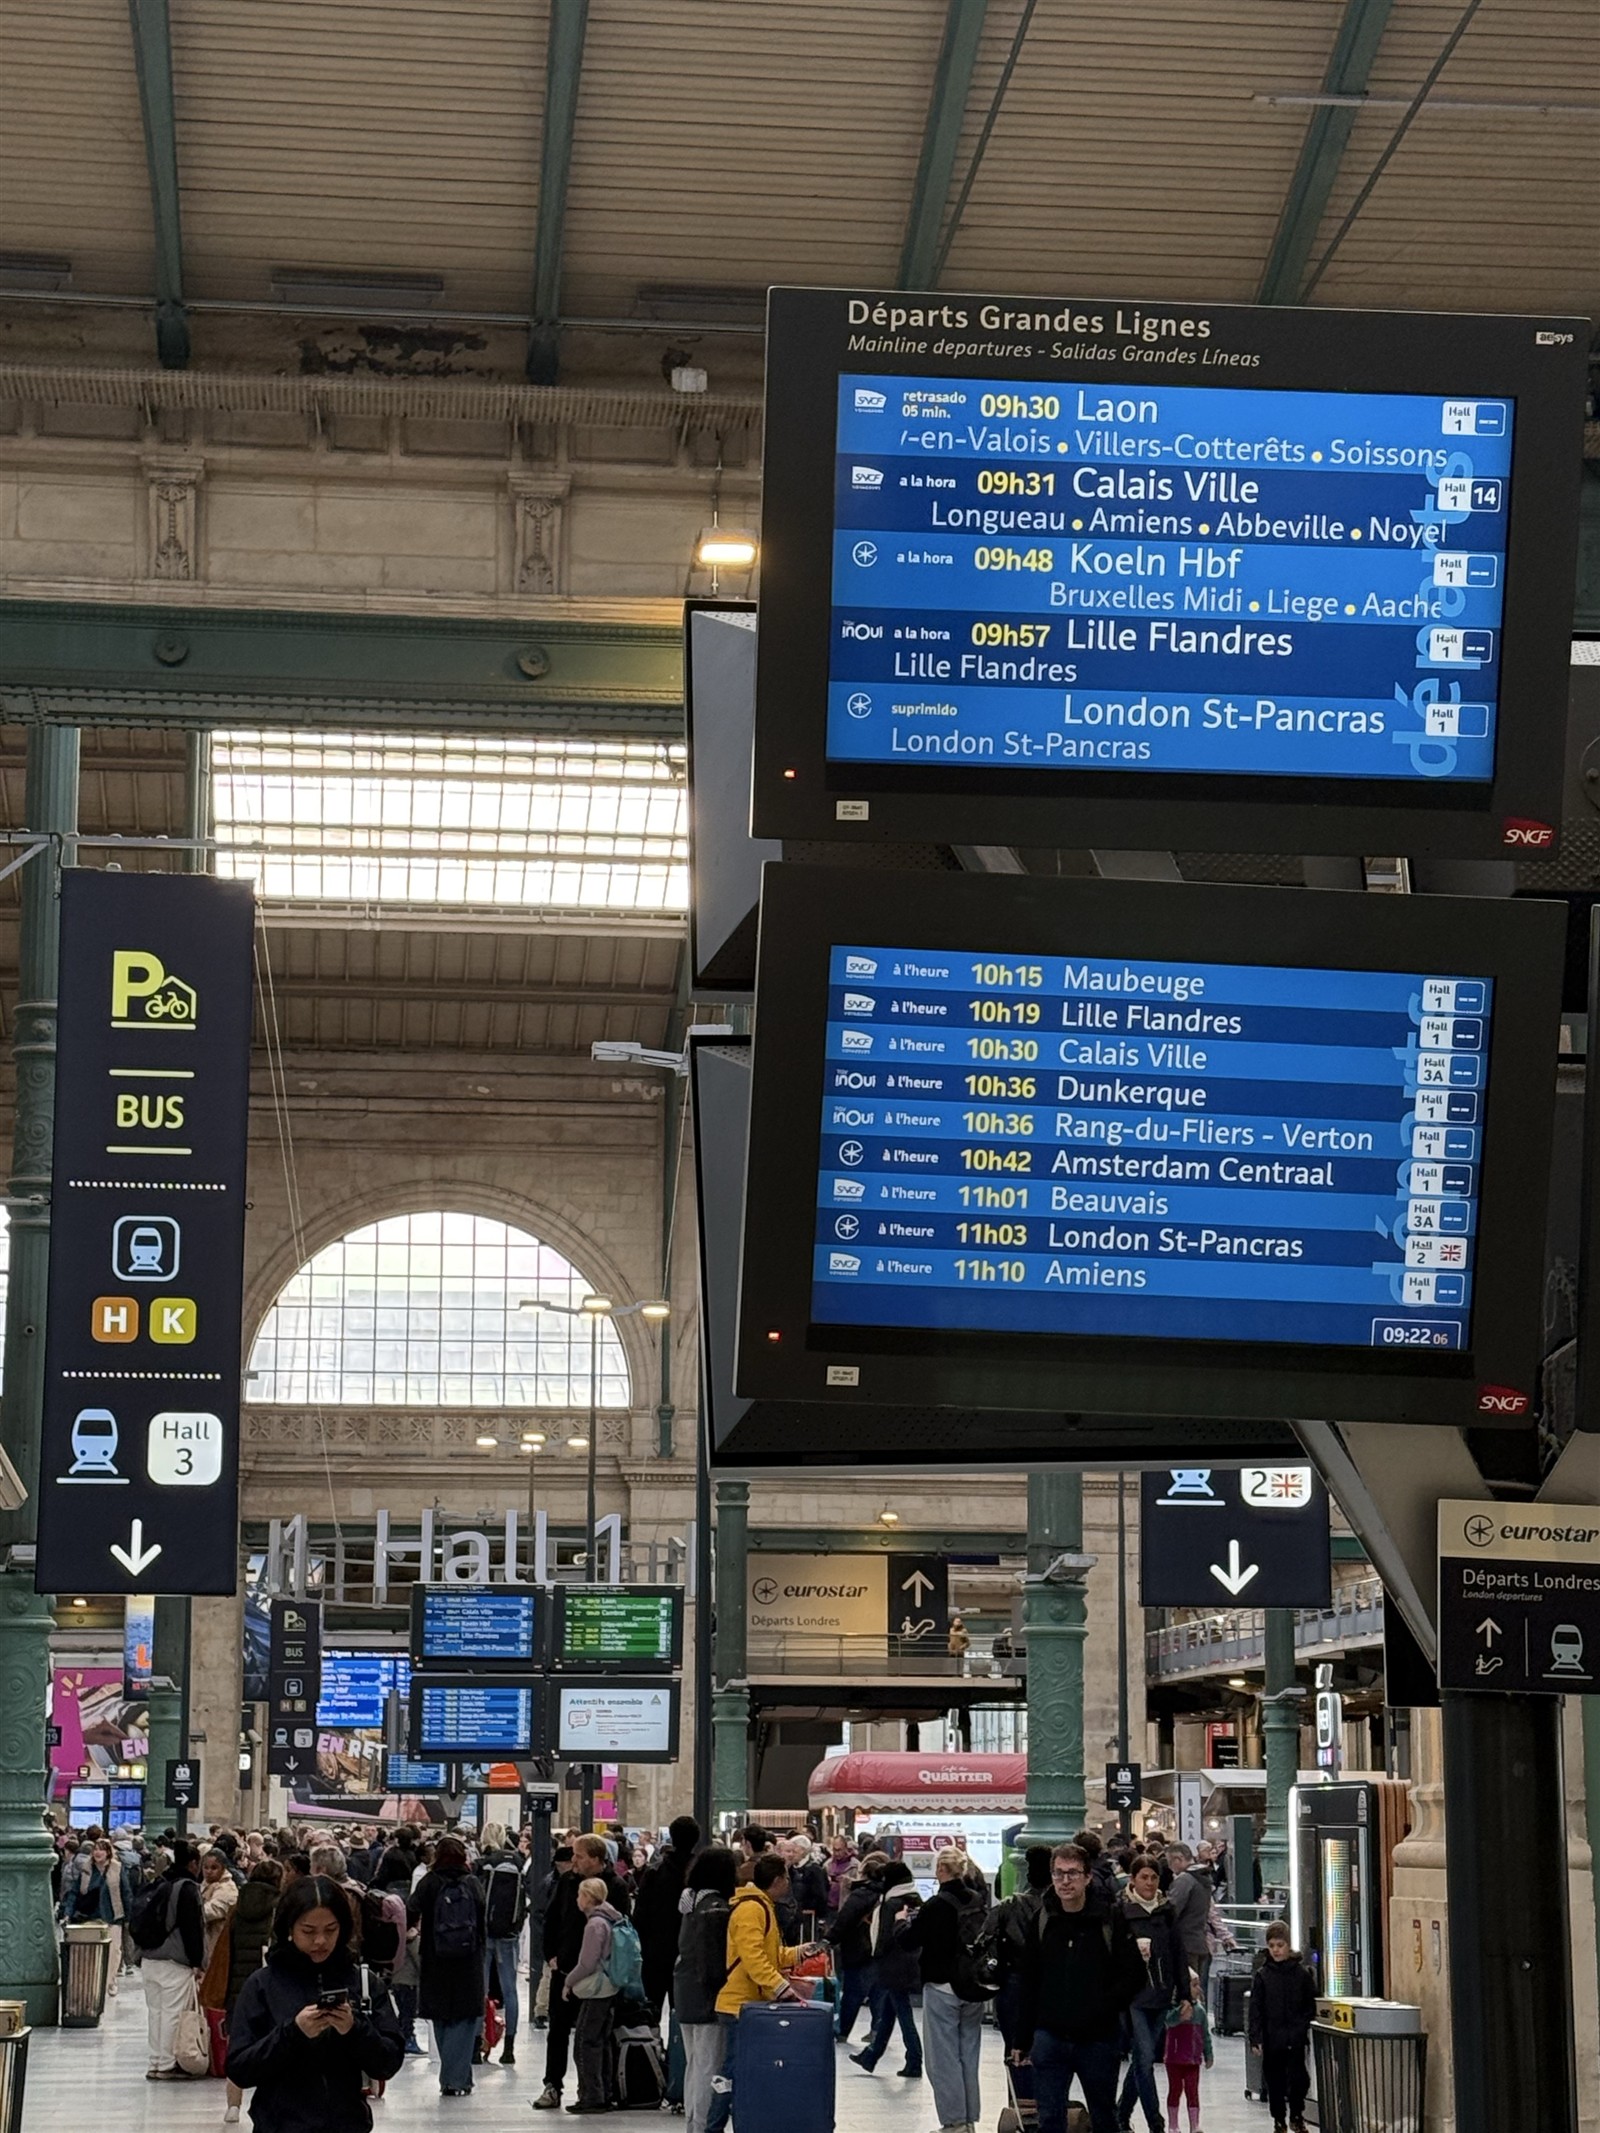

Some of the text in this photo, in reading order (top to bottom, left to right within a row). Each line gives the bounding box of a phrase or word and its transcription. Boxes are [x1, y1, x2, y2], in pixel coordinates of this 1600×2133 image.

[848, 300, 1211, 341] Départs Grandes Lignes
[848, 335, 1260, 367] Mainline departures Salidas Grandes Líneas
[902, 405, 951, 419] 05 min.
[903, 390, 1159, 423] retrasado 09h30 Laon
[1449, 405, 1471, 417] Hall
[1454, 419, 1463, 432] 1
[1075, 430, 1305, 463] Villers-Cotterêts
[1329, 438, 1448, 468] Soissons
[899, 467, 1259, 504] a la hora 09h31 Calais Ville
[1444, 483, 1497, 506] Hall 14
[1450, 495, 1458, 508] 1
[931, 501, 1448, 549] Longueau Amiens Abbeville Noyel
[896, 543, 1243, 579] a la hora 09h48 Koeln Hbf
[1440, 558, 1462, 570] Hall
[1445, 571, 1454, 583] 1
[1050, 582, 1442, 621] Bruxelles Midi Liege Aache
[893, 629, 903, 639] a
[905, 626, 918, 640] la
[920, 627, 951, 640] hora
[971, 622, 1051, 648] 09h57
[1066, 619, 1137, 651] Lille
[1150, 621, 1294, 656] Flandres
[1435, 633, 1458, 645] Hall
[1442, 646, 1450, 658] 1
[894, 652, 1078, 682] Lille Flandres
[891, 694, 1385, 734] suprimido London St-Pancras
[1432, 708, 1454, 719] Hall
[1438, 720, 1446, 733] 1
[891, 727, 1151, 760] London St-Pancras
[1504, 829, 1552, 844] SNCF
[111, 950, 165, 1018] P
[893, 962, 1204, 1000] à l'heure 10h15 Maubeuge
[1430, 984, 1450, 994] Hall
[1434, 996, 1442, 1009] 1
[891, 1000, 1242, 1034] à l'heure 10h19 Lille Flandres
[1426, 1020, 1448, 1032] Hall
[1432, 1034, 1440, 1046] 1
[889, 1038, 1207, 1069] à l'heure 10h30 Calais Ville
[1424, 1057, 1445, 1068] Hall
[1424, 1070, 1443, 1082] 3A
[886, 1074, 1206, 1112] à l'heure 10h36 Dunkerque
[1421, 1094, 1442, 1105] Hall
[116, 1094, 185, 1129] BUS
[1427, 1106, 1435, 1118] 1
[884, 1112, 1373, 1150] à l'heure 10h36 Rang-du-Fliers Verton
[1419, 1130, 1440, 1142] Hall
[1424, 1142, 1432, 1155] 1
[882, 1148, 1334, 1186] à l'heure 10h42 Amsterdam Centraal
[1416, 1167, 1438, 1178] Hall
[1422, 1180, 1430, 1192] 1
[880, 1185, 1169, 1216] à l'heure 11h01 Beauvais
[1414, 1204, 1435, 1214] Hall
[1414, 1216, 1434, 1228] 3A
[878, 1222, 1303, 1258] à l'heure 11h03 London St-Pancras
[1412, 1240, 1433, 1251] Hall
[1416, 1252, 1426, 1265] 2
[876, 1260, 1148, 1288] à l'heure 11h10 Amiens
[1409, 1276, 1430, 1288] Hall
[1415, 1289, 1423, 1301] 1
[102, 1305, 185, 1335] H K
[1382, 1326, 1448, 1345] 09:22 06
[1479, 1396, 1527, 1411] SNCF
[162, 1420, 210, 1440] Hall
[173, 1447, 194, 1476] 3
[1250, 1471, 1268, 1498] 2
[1500, 1525, 1600, 1543] eurostar
[375, 1509, 621, 1599] Hall 1
[1463, 1569, 1600, 1591] Départs Londres
[783, 1584, 868, 1599] eurostar
[1462, 1589, 1543, 1602] London departures
[283, 1610, 298, 1629] P
[751, 1614, 841, 1628] Départs Londres
[285, 1647, 304, 1658] BUS
[121, 1738, 149, 1760] EN
[317, 1733, 345, 1754] EN
[918, 1770, 993, 1784] QUARTIER
